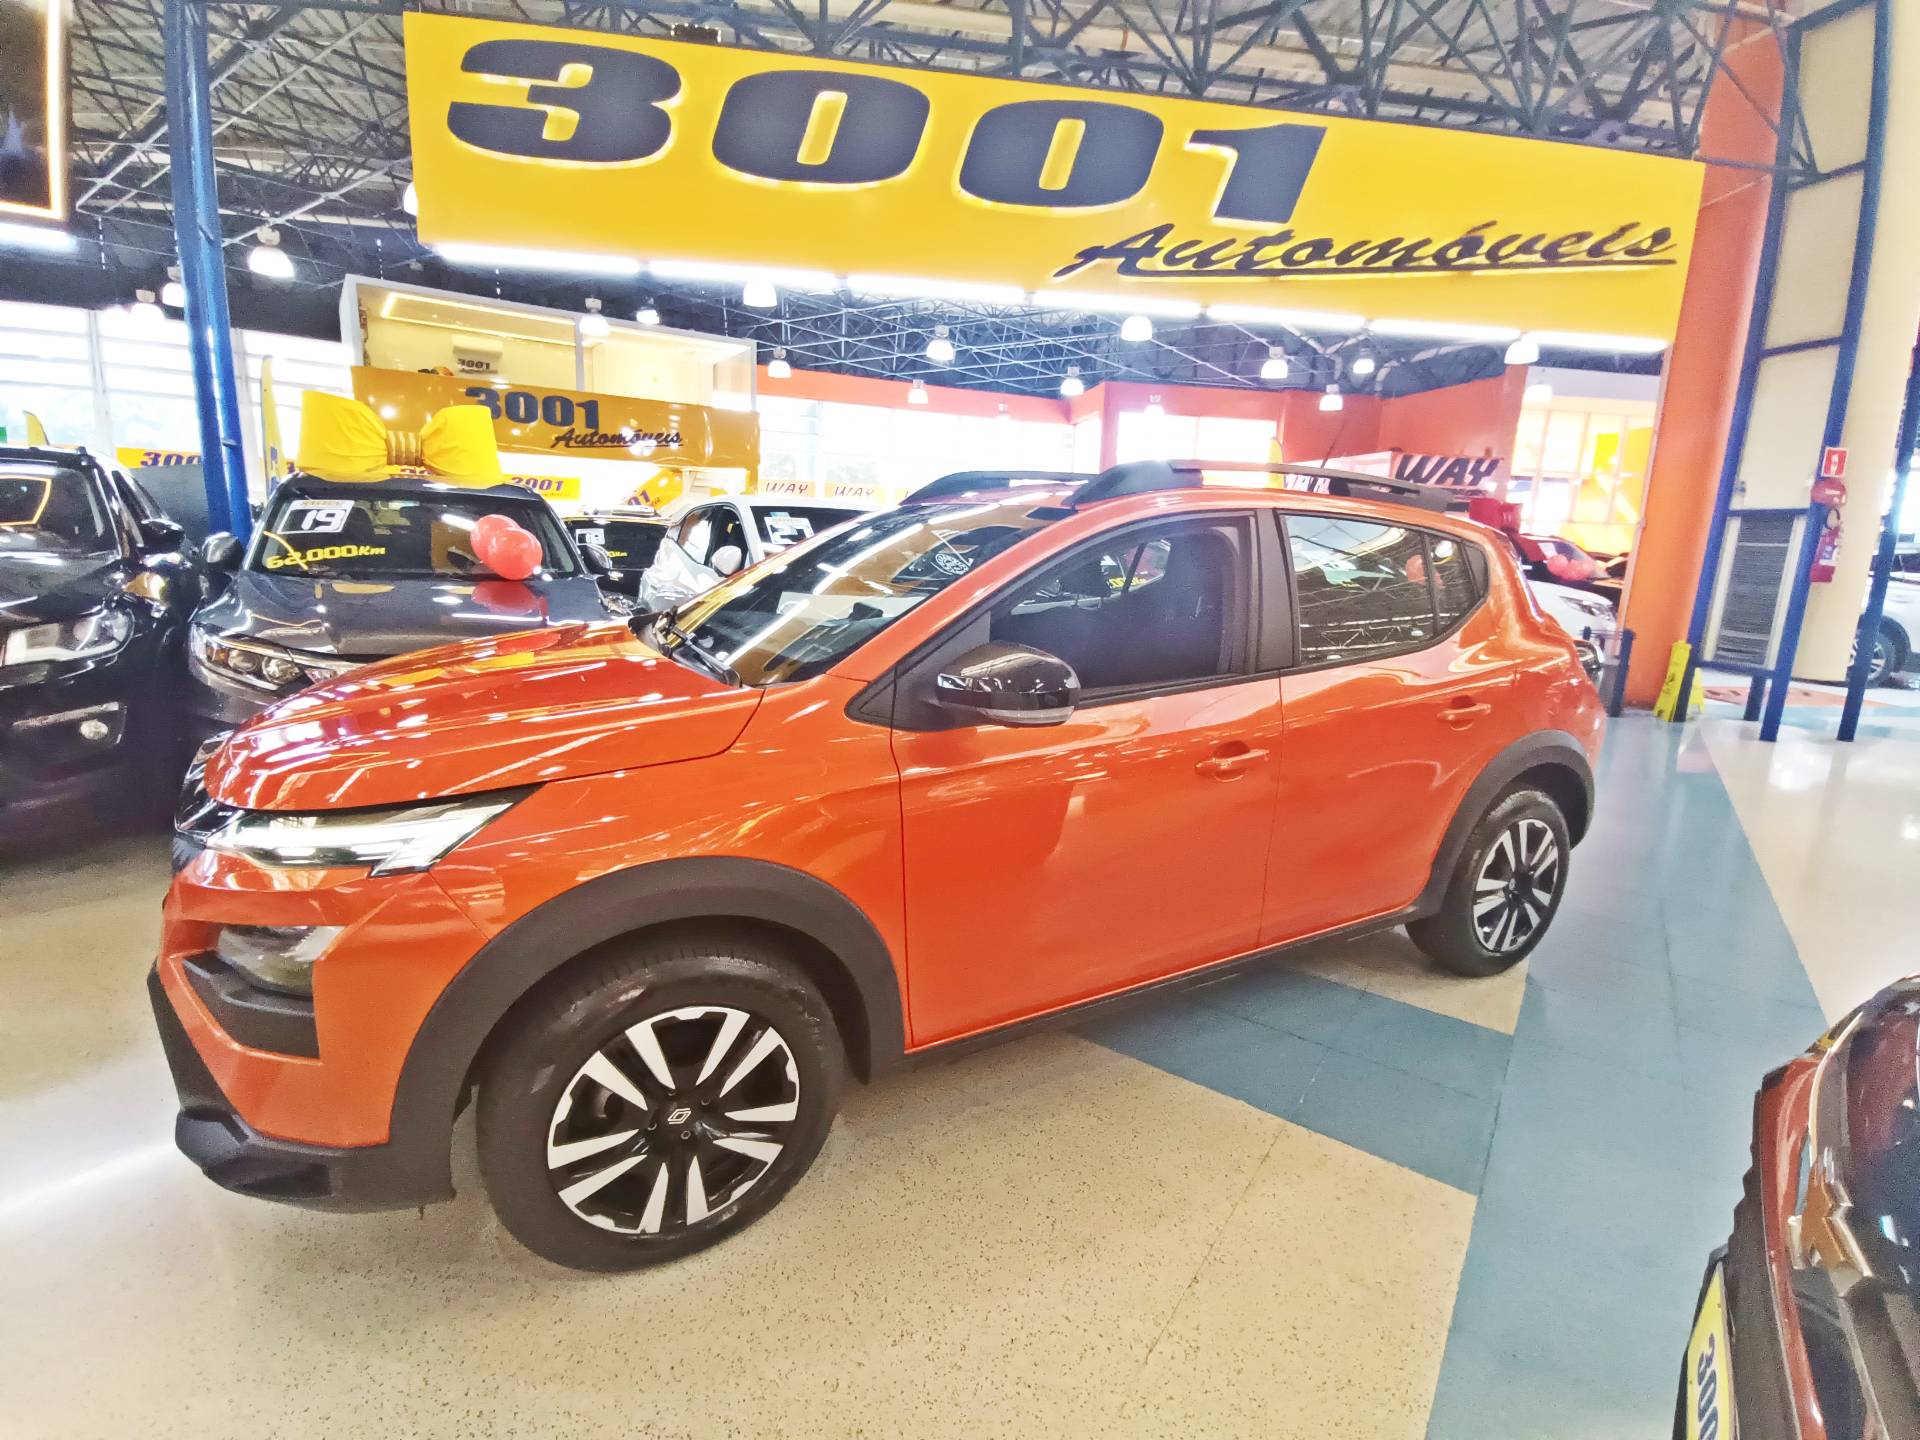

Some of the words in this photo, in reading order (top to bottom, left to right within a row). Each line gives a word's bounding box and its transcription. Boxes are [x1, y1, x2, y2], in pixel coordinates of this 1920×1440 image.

[446, 38, 1328, 224] 3001
[1052, 219, 1676, 279] Automóveis
[465, 386, 599, 430] 3001
[765, 482, 809, 494] WAY
[1395, 453, 1500, 487] WAY
[301, 509, 346, 531] 19
